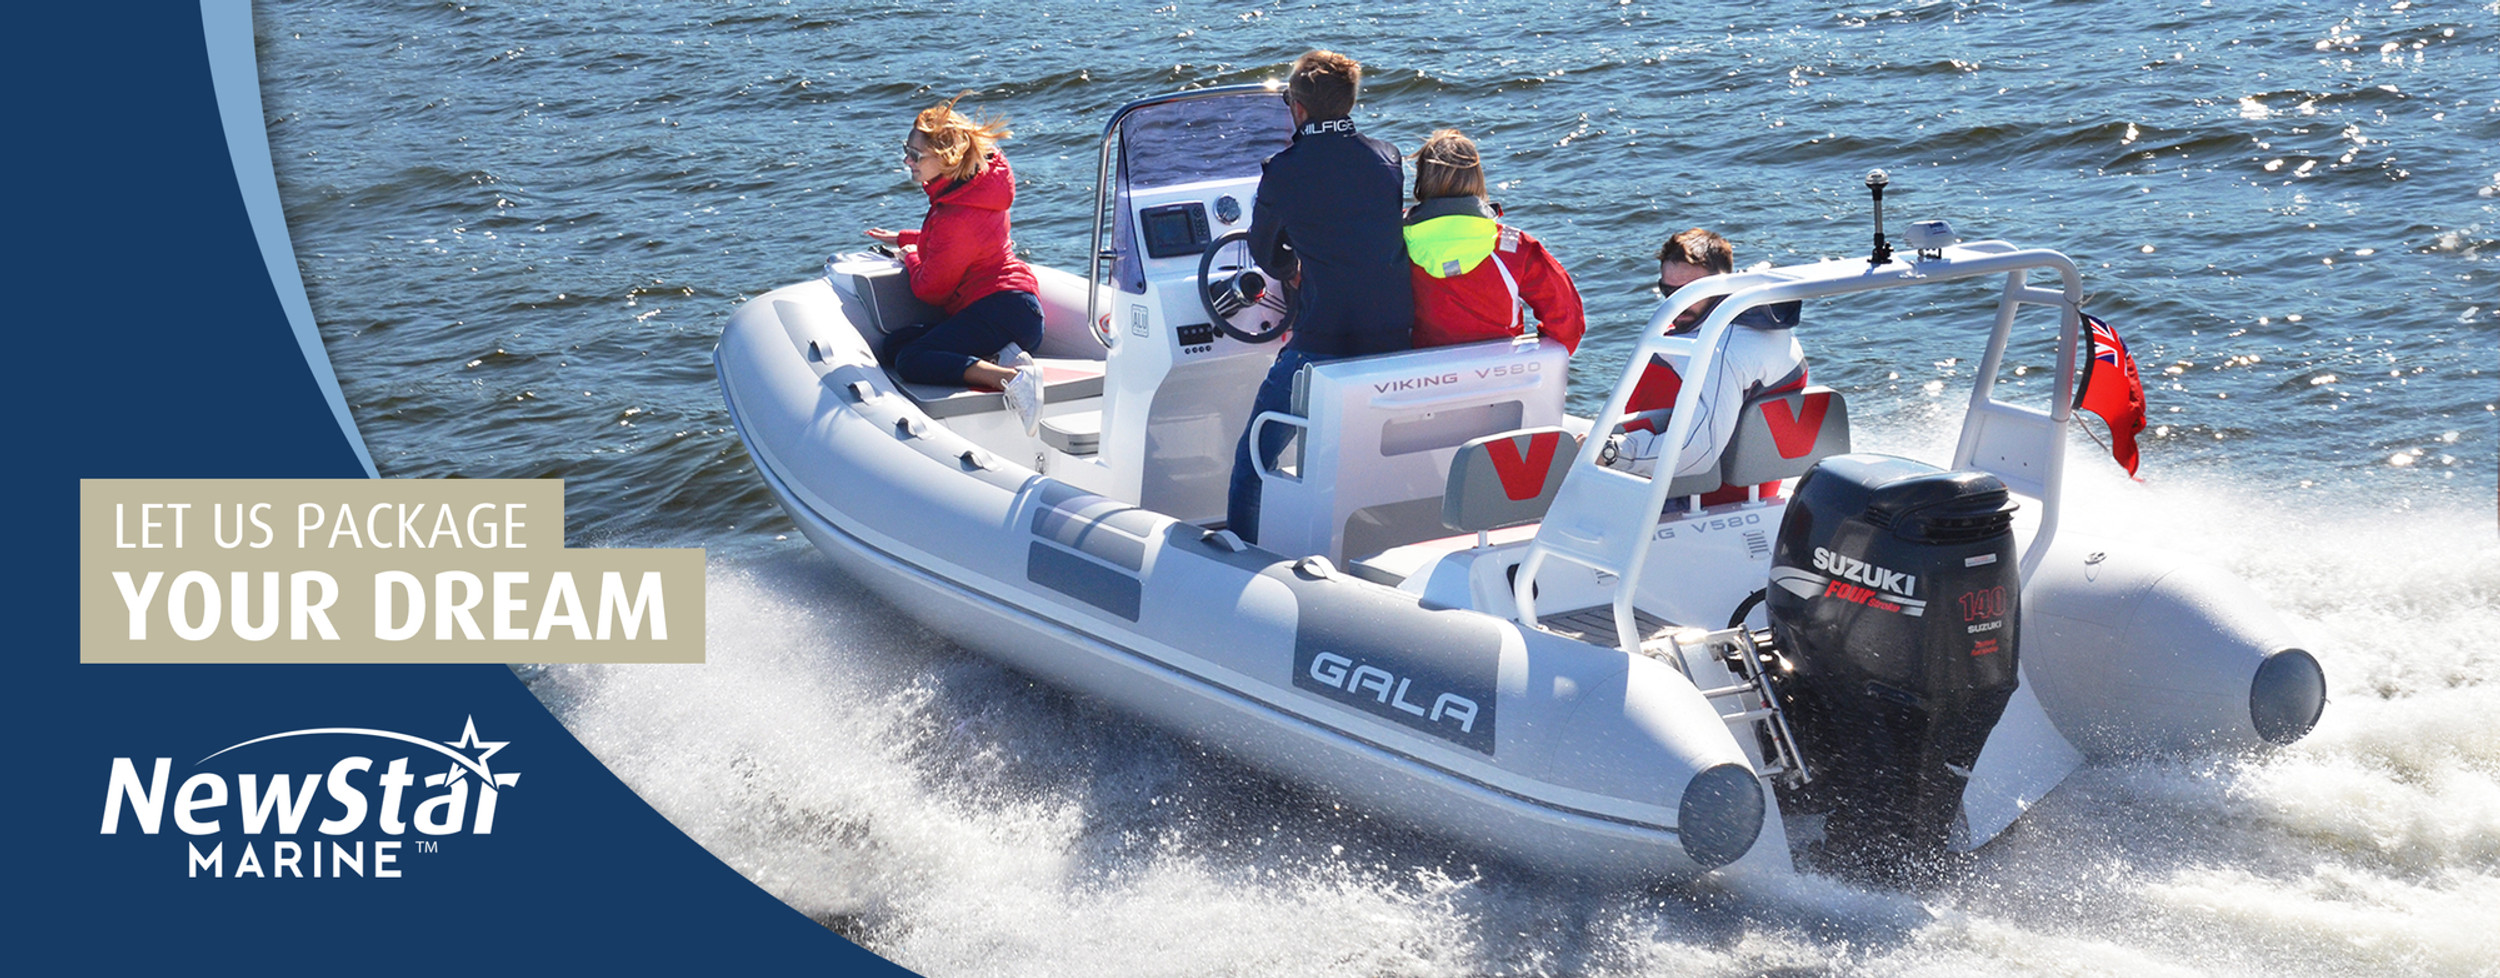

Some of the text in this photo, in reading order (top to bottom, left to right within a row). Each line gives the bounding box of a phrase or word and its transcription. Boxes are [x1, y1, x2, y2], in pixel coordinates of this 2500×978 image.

[1374, 361, 1541, 394] VIKING V580
[1691, 513, 1760, 533] V580
[1813, 547, 1916, 597] SUZUKI
[1959, 586, 2006, 622] 140
[1968, 620, 2002, 634] SUZUKI
[1310, 652, 1478, 733] GALA
